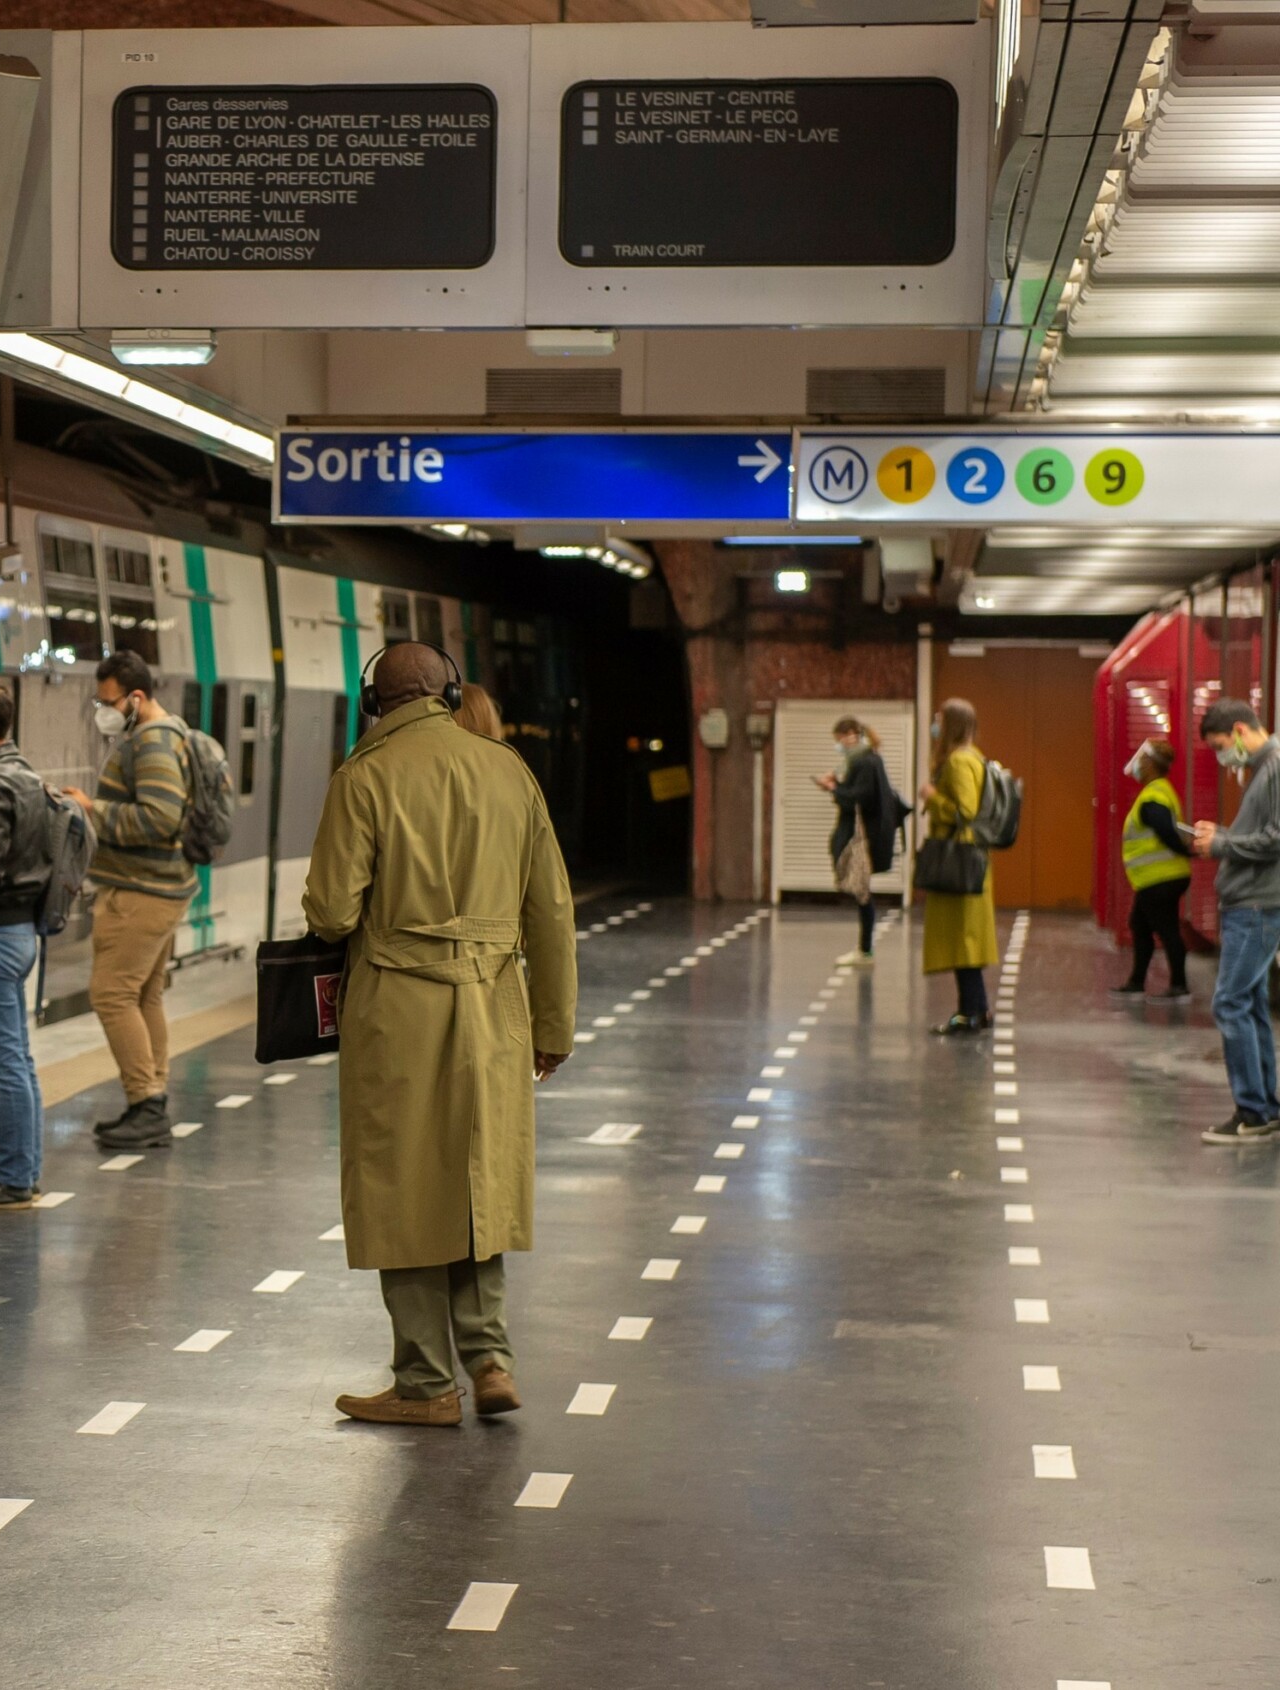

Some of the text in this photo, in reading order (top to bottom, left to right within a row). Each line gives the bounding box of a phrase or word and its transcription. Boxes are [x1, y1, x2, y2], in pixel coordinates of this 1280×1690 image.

[166, 97, 289, 112] Gares desservies
[615, 91, 637, 107] LE
[166, 115, 212, 130] GARE
[217, 115, 241, 130] DE
[427, 113, 491, 129] HALLES
[615, 110, 636, 126] LE
[750, 109, 799, 125] PECQ
[316, 133, 339, 148] DE
[165, 151, 425, 168] GRANDE ARCHE DE LA DEFENSE
[612, 244, 705, 257] TRAIN COURT
[286, 436, 445, 483] Sortie
[822, 457, 1127, 494] M 1 2 6 9
